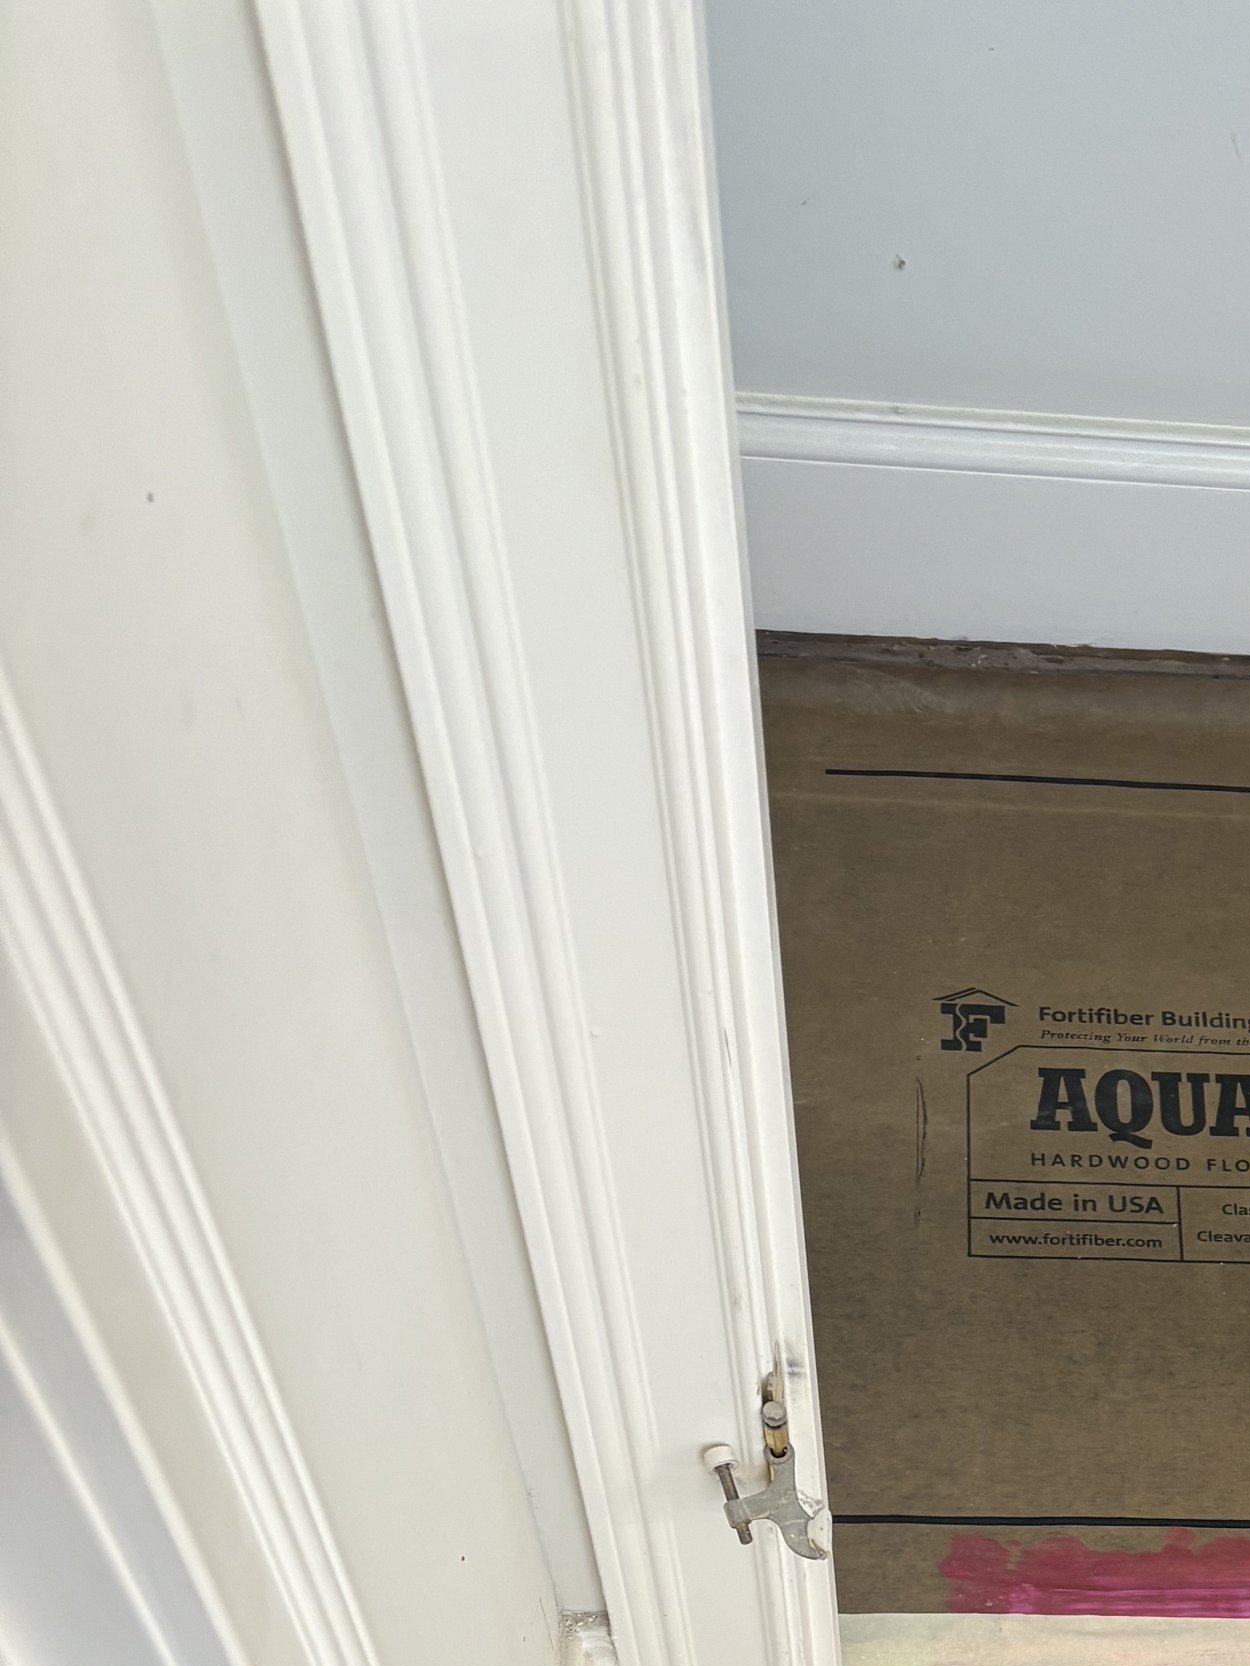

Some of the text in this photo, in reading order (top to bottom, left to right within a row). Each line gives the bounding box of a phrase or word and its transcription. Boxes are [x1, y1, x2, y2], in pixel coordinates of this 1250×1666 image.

[1039, 1006, 1153, 1026] Fortifiber
[1040, 1030, 1111, 1043] Protecting
[1117, 1033, 1148, 1043] Your
[1153, 1034, 1193, 1044] World
[1199, 1035, 1230, 1046] from
[1031, 1152, 1190, 1171] HARDWOOD
[984, 1191, 1165, 1214] Made in USA
[988, 1233, 1163, 1248] www.fortifiber.com
